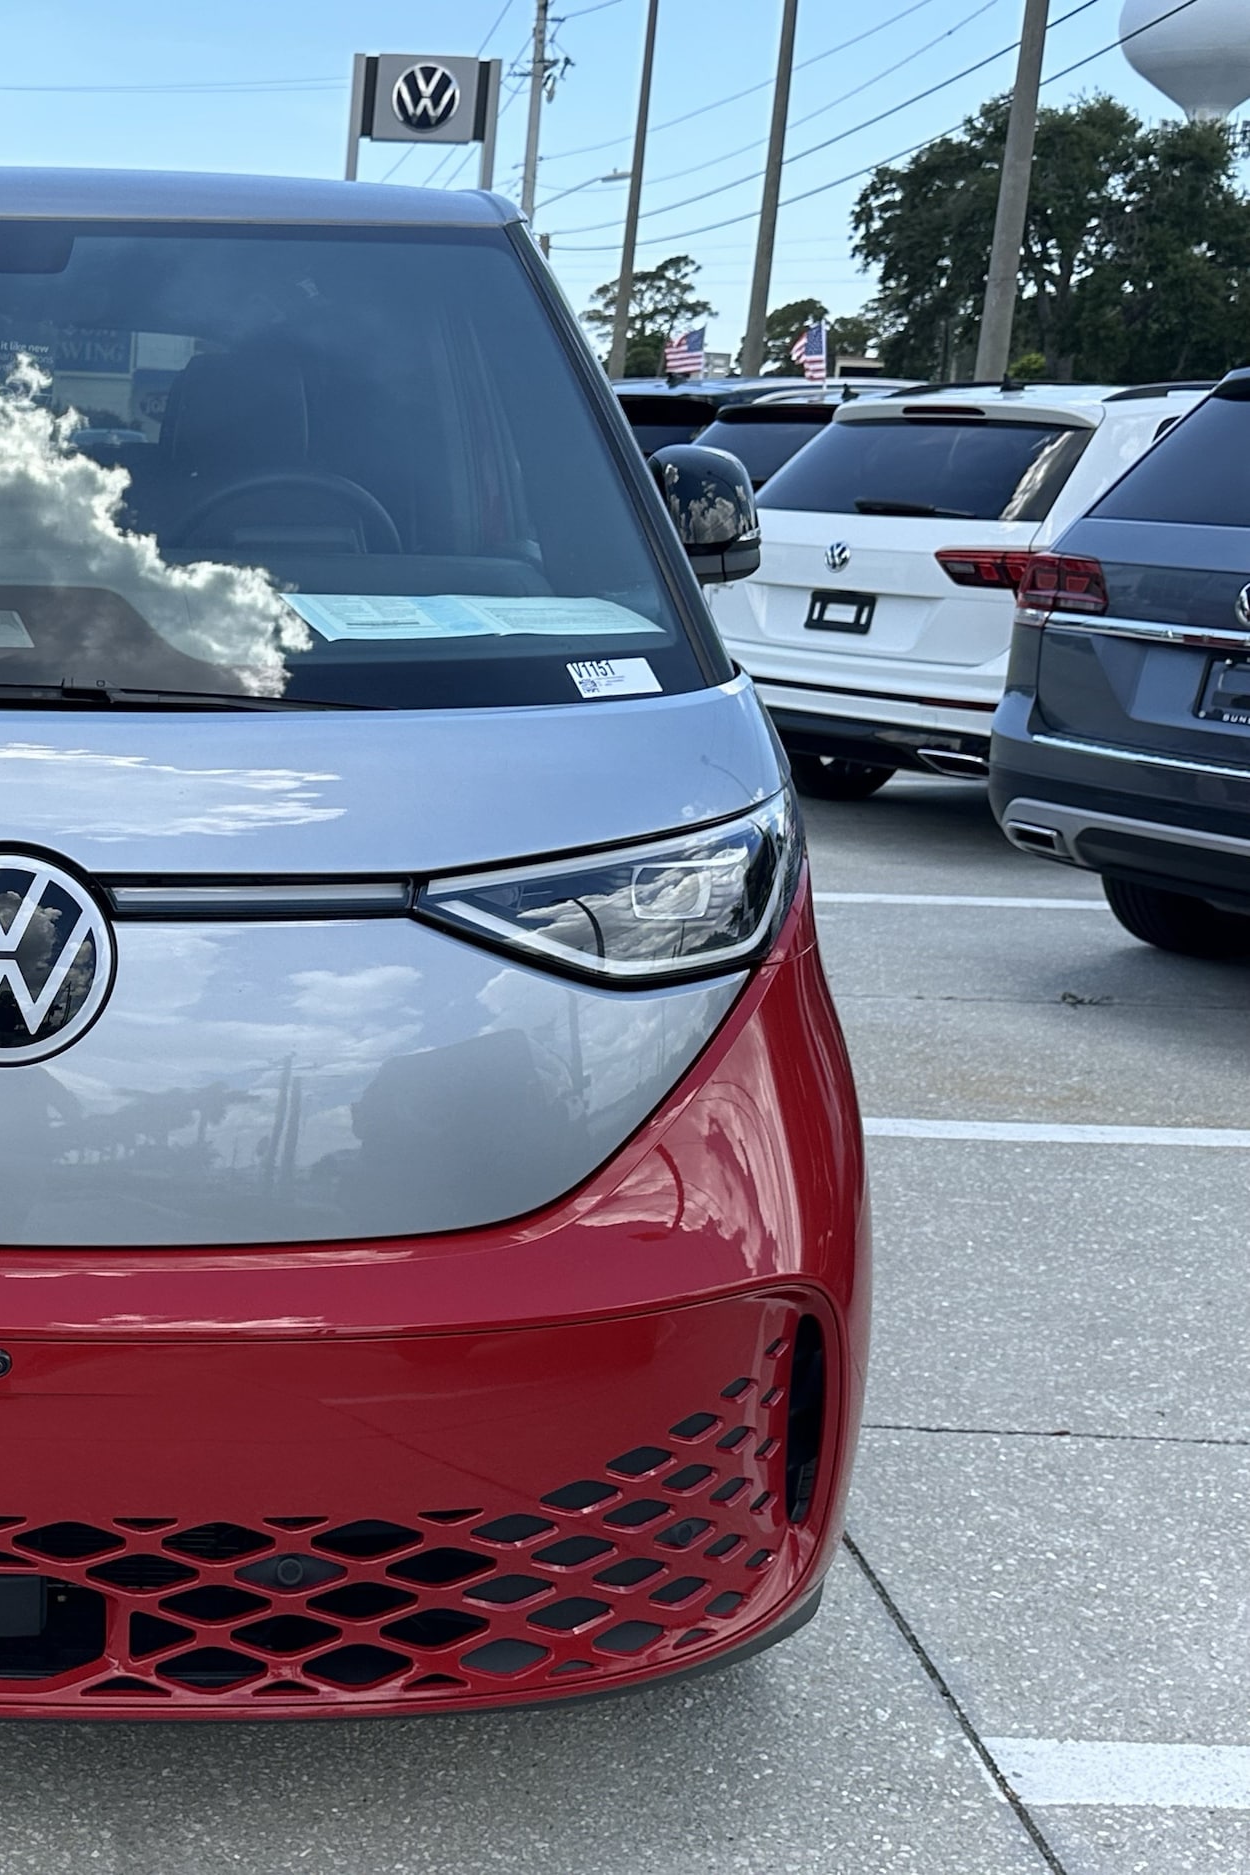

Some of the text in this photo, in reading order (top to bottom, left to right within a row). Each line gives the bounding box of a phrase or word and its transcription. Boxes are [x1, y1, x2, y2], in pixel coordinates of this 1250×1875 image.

[393, 63, 460, 133] VW
[28, 344, 49, 353] new
[571, 660, 616, 678] V1151
